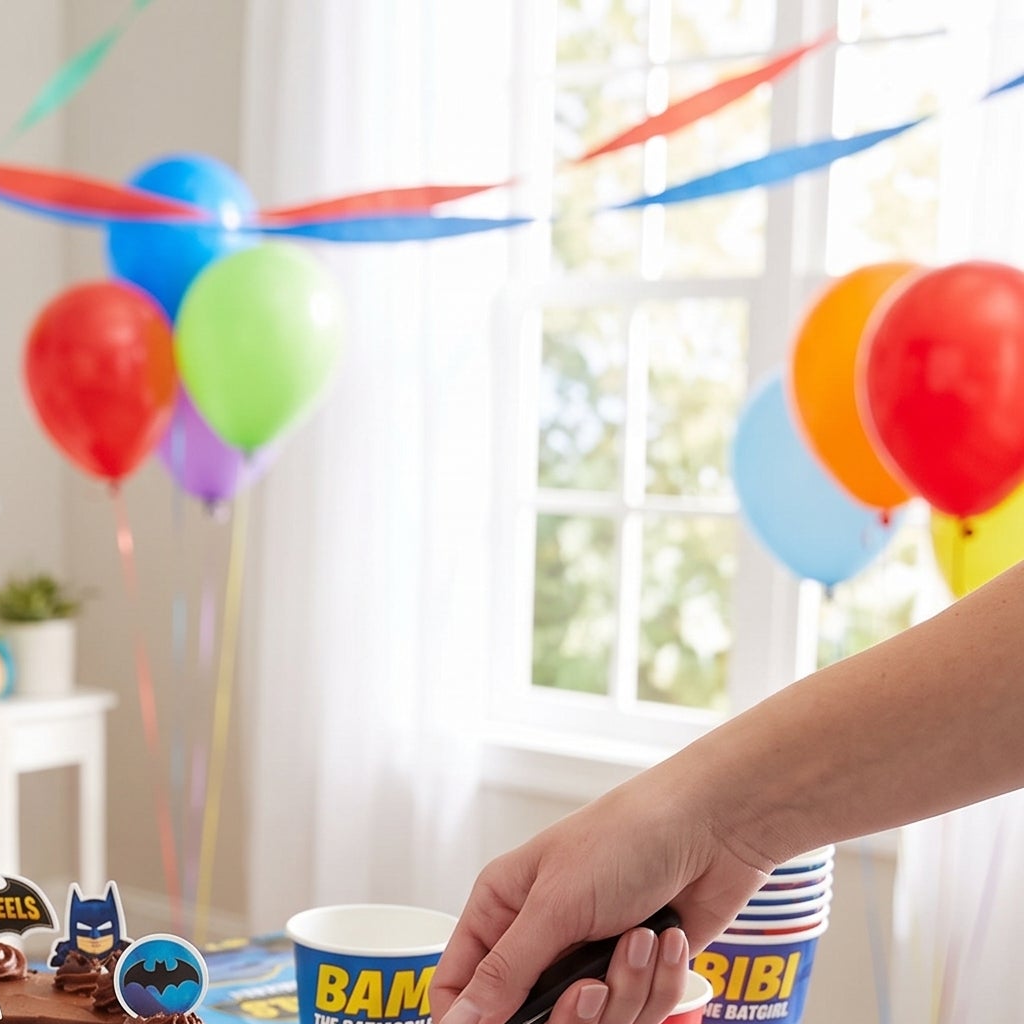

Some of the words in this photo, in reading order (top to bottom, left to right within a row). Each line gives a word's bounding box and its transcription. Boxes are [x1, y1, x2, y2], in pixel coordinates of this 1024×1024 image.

[316, 964, 437, 1018] BAM
[693, 951, 801, 1002] BIBI
[704, 1003, 723, 1019] HE
[724, 1002, 789, 1020] BATGIRL
